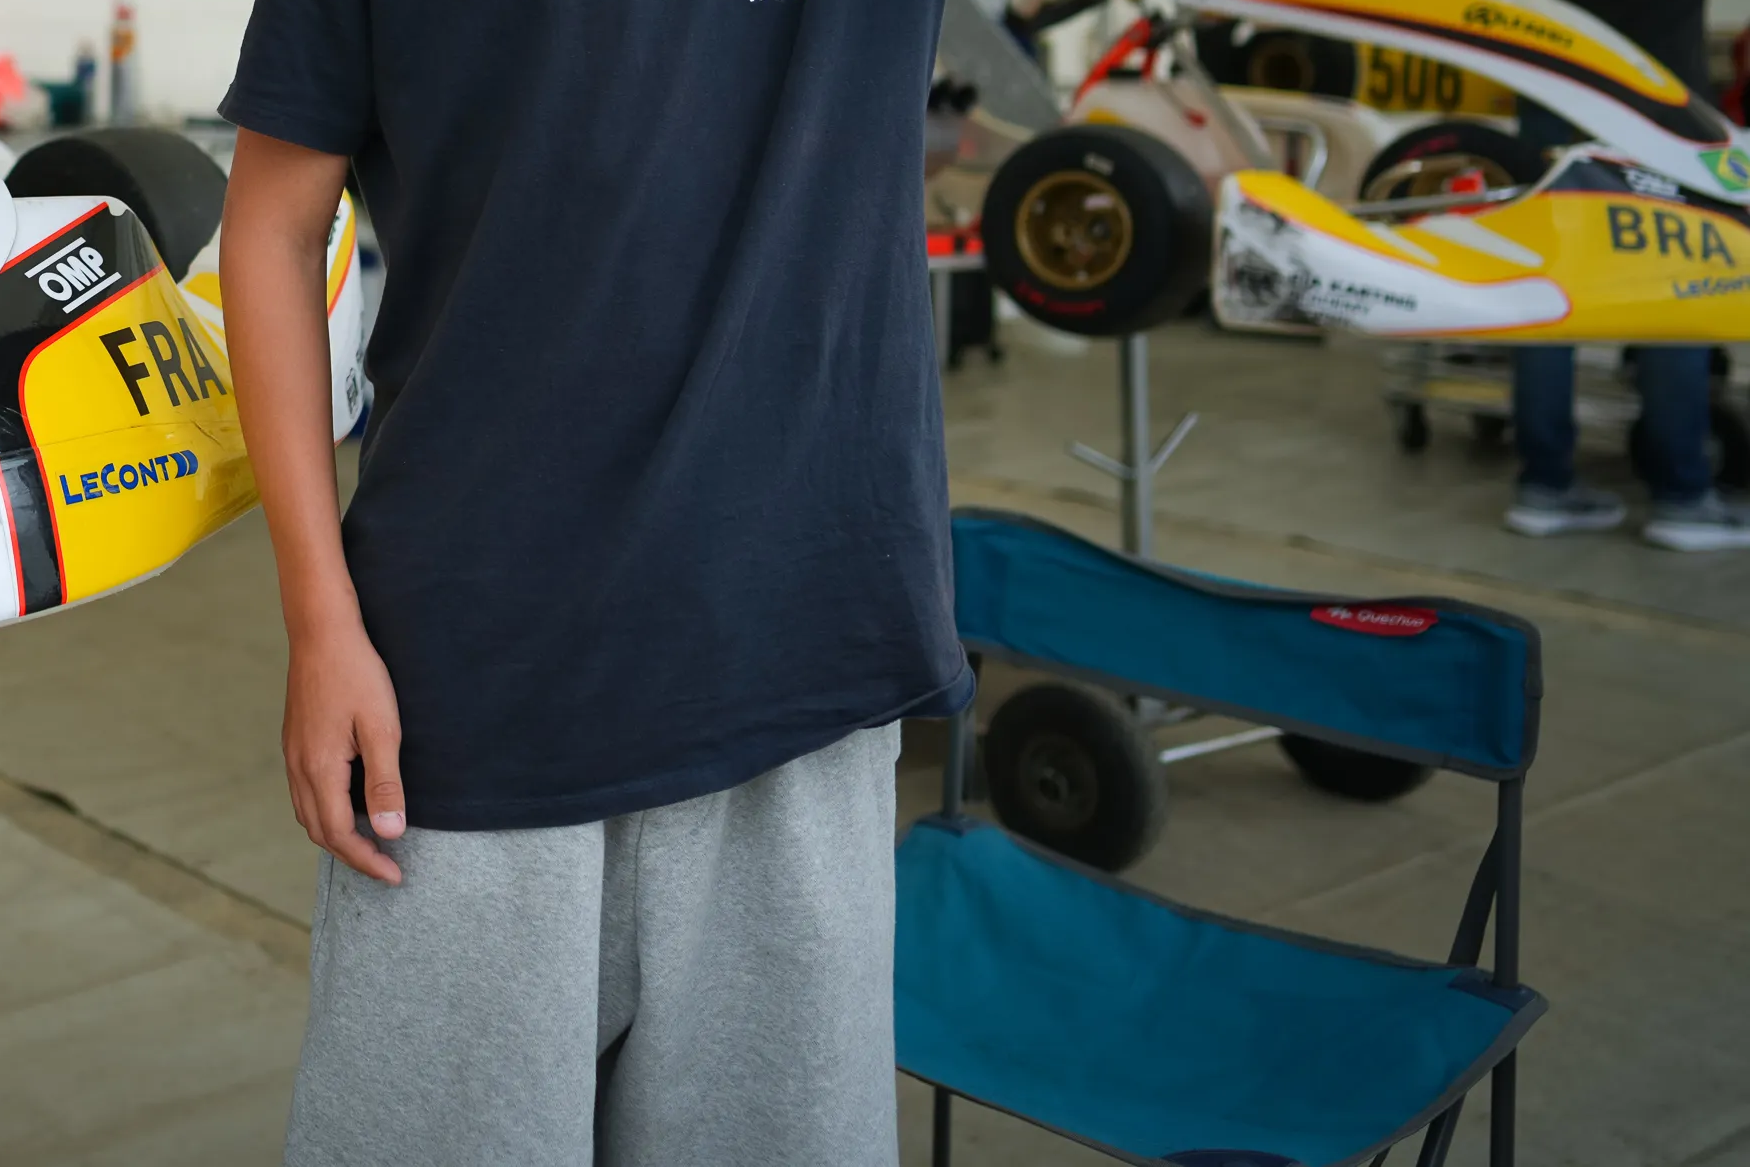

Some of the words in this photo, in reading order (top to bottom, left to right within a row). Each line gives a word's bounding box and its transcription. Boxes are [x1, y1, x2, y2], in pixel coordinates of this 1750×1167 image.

[1607, 203, 1736, 269] BRA
[38, 246, 107, 302] OMP
[99, 316, 227, 417] FRA
